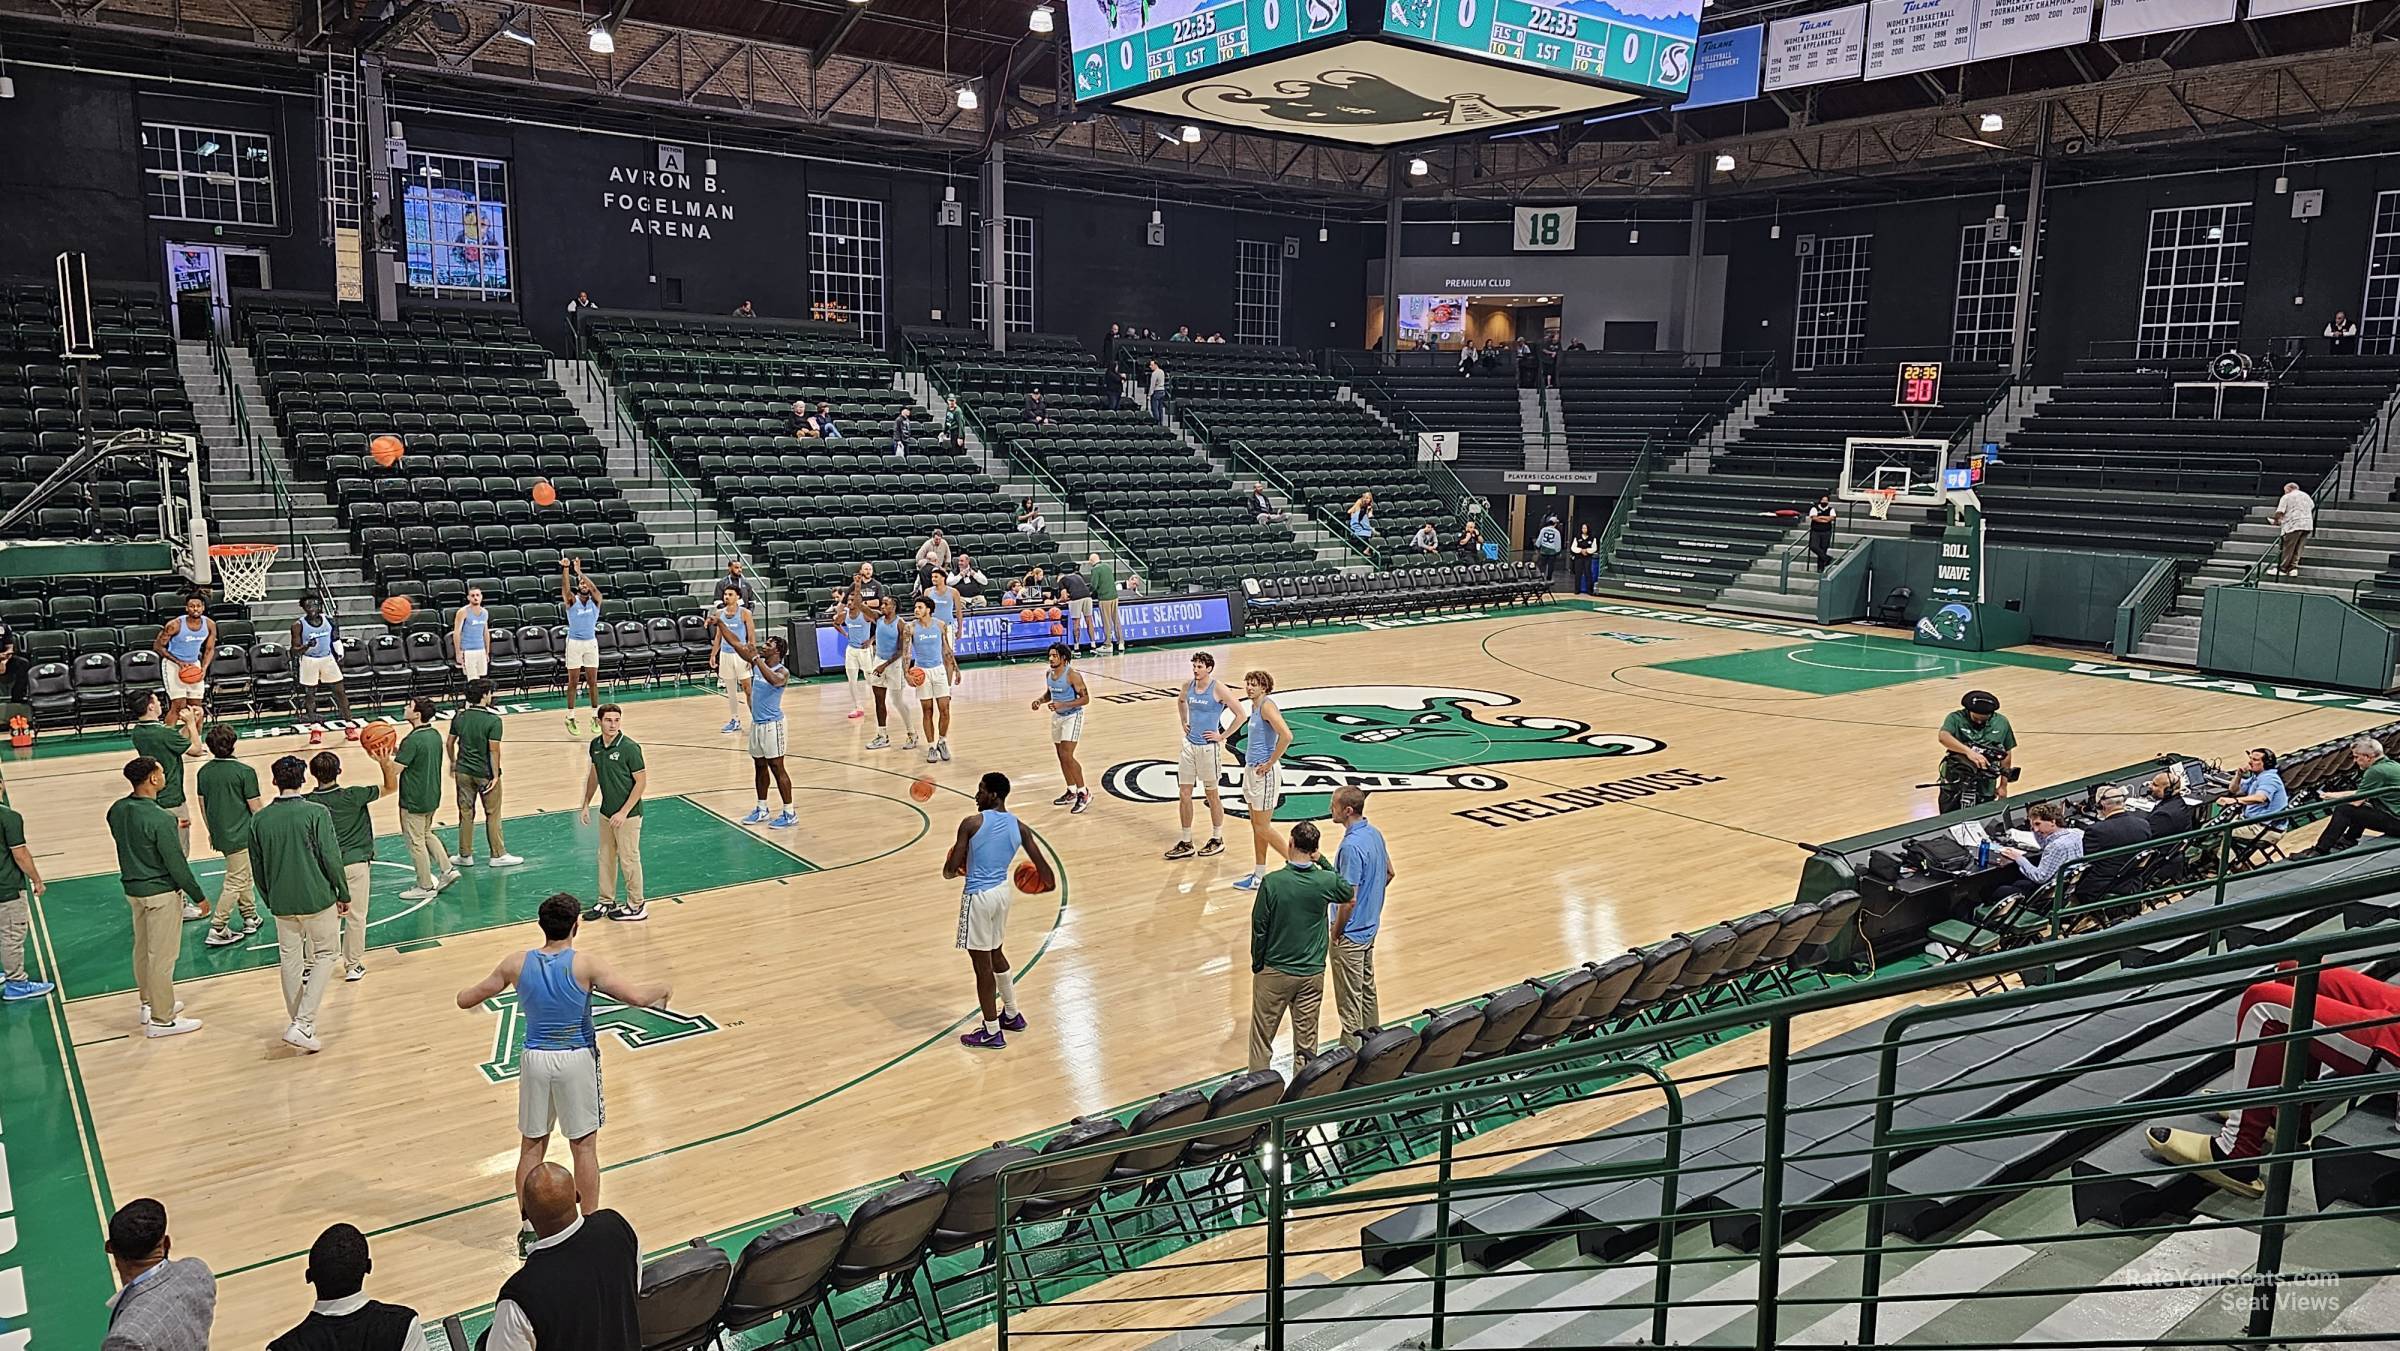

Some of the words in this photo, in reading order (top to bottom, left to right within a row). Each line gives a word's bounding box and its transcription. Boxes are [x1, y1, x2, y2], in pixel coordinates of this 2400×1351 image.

[1264, 0, 1280, 30] 0
[1458, 0, 1476, 28] 0
[1991, 2, 2034, 17] TOURNAMENT
[1528, 6, 1578, 38] 22:35
[1886, 17, 1914, 28] WOMEN'S
[1916, 9, 1954, 23] BASKETBALL
[1980, 21, 1992, 30] 1997
[2024, 13, 2039, 22] 2000
[2048, 10, 2062, 19] 2001
[2073, 6, 2087, 15] 2010
[1172, 11, 1216, 43] 22:35
[1494, 26, 1511, 40] FLS
[1516, 31, 1523, 42] 0
[1799, 20, 1832, 33] TULANE
[1890, 27, 1906, 36] NCAA
[1908, 19, 1949, 33] TOURNAMENT
[1956, 26, 1968, 35] 1999
[1220, 33, 1235, 46] FLS
[1240, 31, 1246, 41] 0
[1784, 36, 1809, 45] WOMEN'S
[1811, 28, 1846, 41] BASKETBALL
[1220, 48, 1233, 60] TO
[1241, 45, 1247, 56] 4
[1492, 43, 1506, 56] TO
[1512, 47, 1521, 59] 4
[1536, 42, 1561, 61] 1ST
[1577, 44, 1593, 58] FLS
[1598, 49, 1604, 60] 0
[1623, 33, 1640, 64] 0
[1787, 44, 1801, 53] WNIT
[1803, 37, 1842, 50] APPEARANCES
[1871, 51, 1884, 59] 2000
[1891, 48, 1904, 56] 2001
[1912, 44, 1925, 52] 2002
[1933, 40, 1946, 49] 2003
[1954, 36, 1967, 45] 2010
[1120, 40, 1133, 71] 0
[1149, 53, 1163, 67] FLS
[1166, 51, 1172, 61] 0
[1185, 48, 1206, 66] 1ST
[1701, 51, 1731, 63] VOLLEYBALL
[1706, 57, 1739, 70] TOURNAMENT
[1150, 68, 1161, 80] TO
[1168, 65, 1174, 76] 4
[1575, 59, 1588, 71] TO
[1595, 63, 1601, 74] 4
[1870, 60, 1882, 69] 2015
[665, 154, 679, 170] A
[609, 166, 691, 190] AVRON
[704, 177, 726, 194] B.
[603, 192, 734, 220] FOGELMAN
[2302, 200, 2313, 214] F
[948, 209, 956, 222] B
[630, 218, 711, 239] ARENA
[1152, 230, 1160, 243] C
[1529, 212, 1561, 246] 18
[1992, 225, 2002, 238] E
[1287, 244, 1296, 256] D
[1800, 241, 1810, 254] D
[1445, 279, 1487, 288] PREMIUM
[1488, 279, 1511, 288] CLUB
[1904, 366, 1937, 380] 22:35
[1906, 380, 1933, 402] 30
[1508, 473, 1537, 481] PLAYERS
[1541, 473, 1573, 481] COACHES
[1543, 532, 1555, 543] 92
[1942, 543, 1970, 559] ROLL
[1938, 565, 1971, 581] WAVE
[1078, 607, 1149, 629] NVILLE
[1153, 602, 1202, 622] SEAFOOD
[1598, 606, 1859, 641] GREEN
[1142, 628, 1148, 637] &
[1155, 624, 1190, 636] EATERY
[953, 639, 997, 653] EATERY
[1450, 768, 1728, 828] FIELDHOUSE
